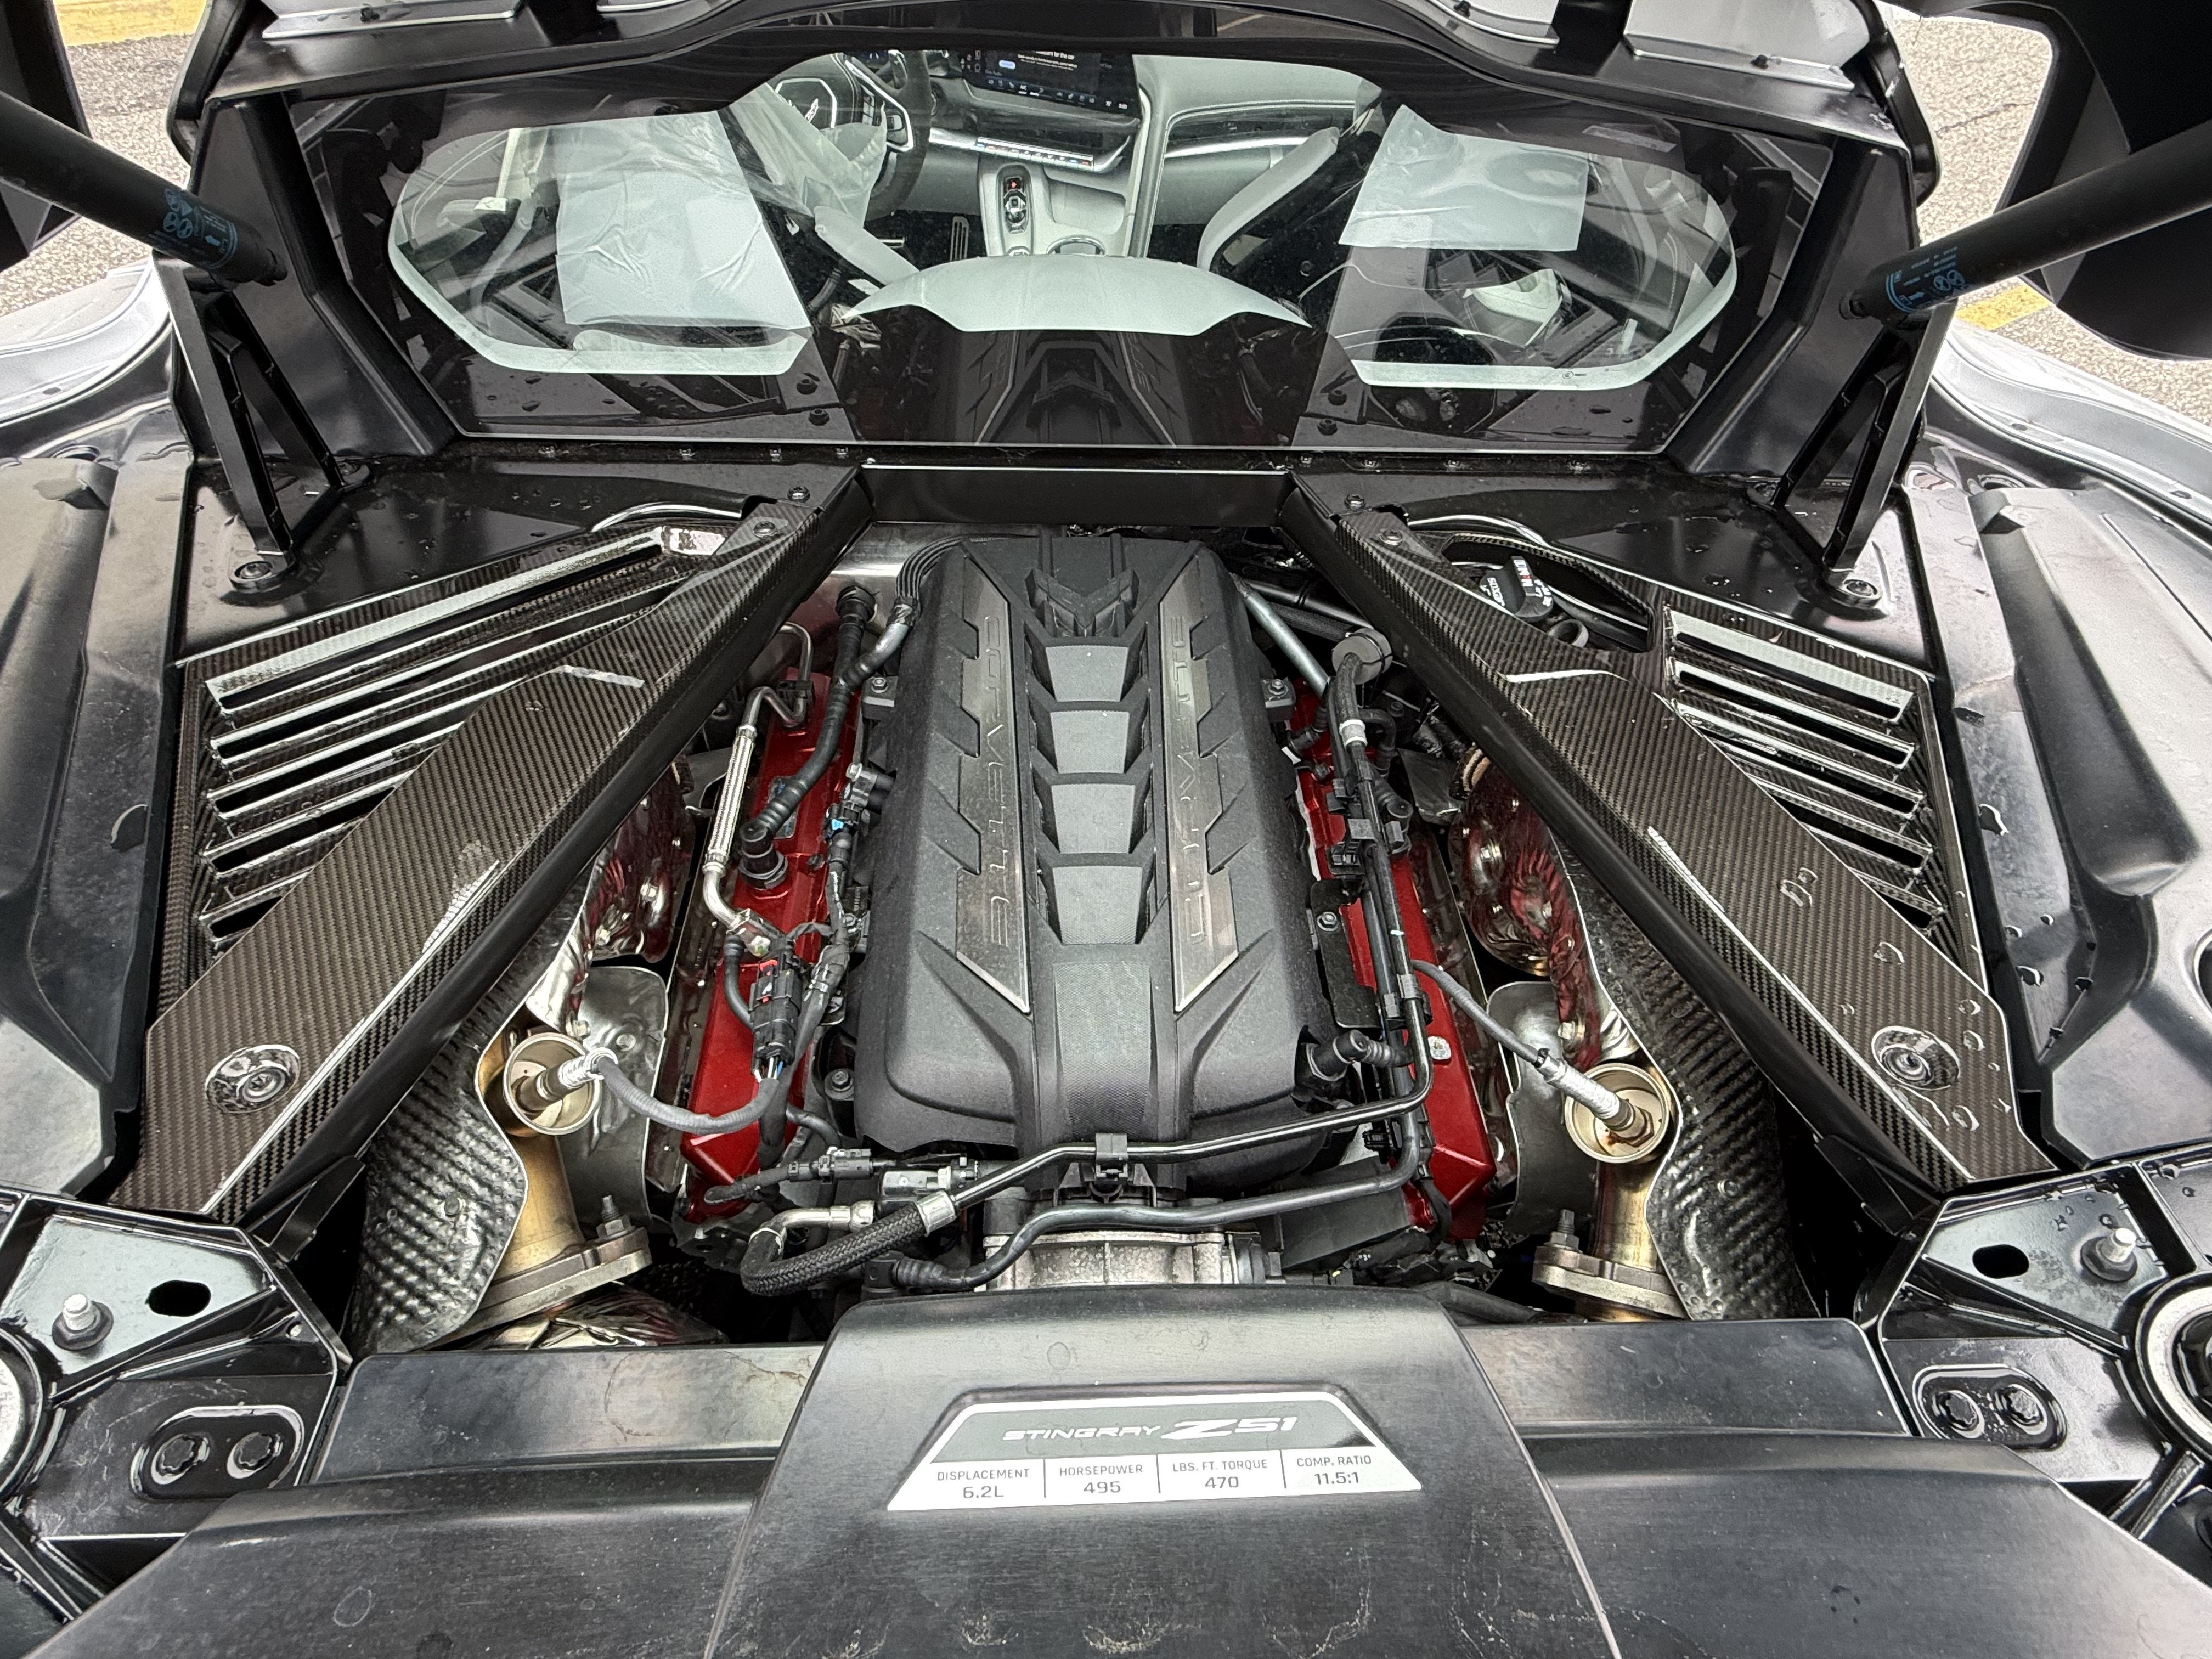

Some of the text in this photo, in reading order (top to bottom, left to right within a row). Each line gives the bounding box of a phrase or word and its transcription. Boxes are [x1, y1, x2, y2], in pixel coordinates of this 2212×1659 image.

[1002, 1416, 1297, 1441] STINGRAY Z51
[1172, 1462, 1199, 1472] LBS.
[1222, 1459, 1268, 1471] TORQUE
[1296, 1455, 1372, 1468] COMP. RATIO
[936, 1468, 1030, 1481] DISPLACEMENT
[1059, 1464, 1143, 1476] HORSEPOWER
[1205, 1476, 1239, 1489] 470
[1314, 1471, 1359, 1485] 11.5:1
[963, 1485, 1004, 1499] 6.2L
[1083, 1481, 1121, 1493] 495
